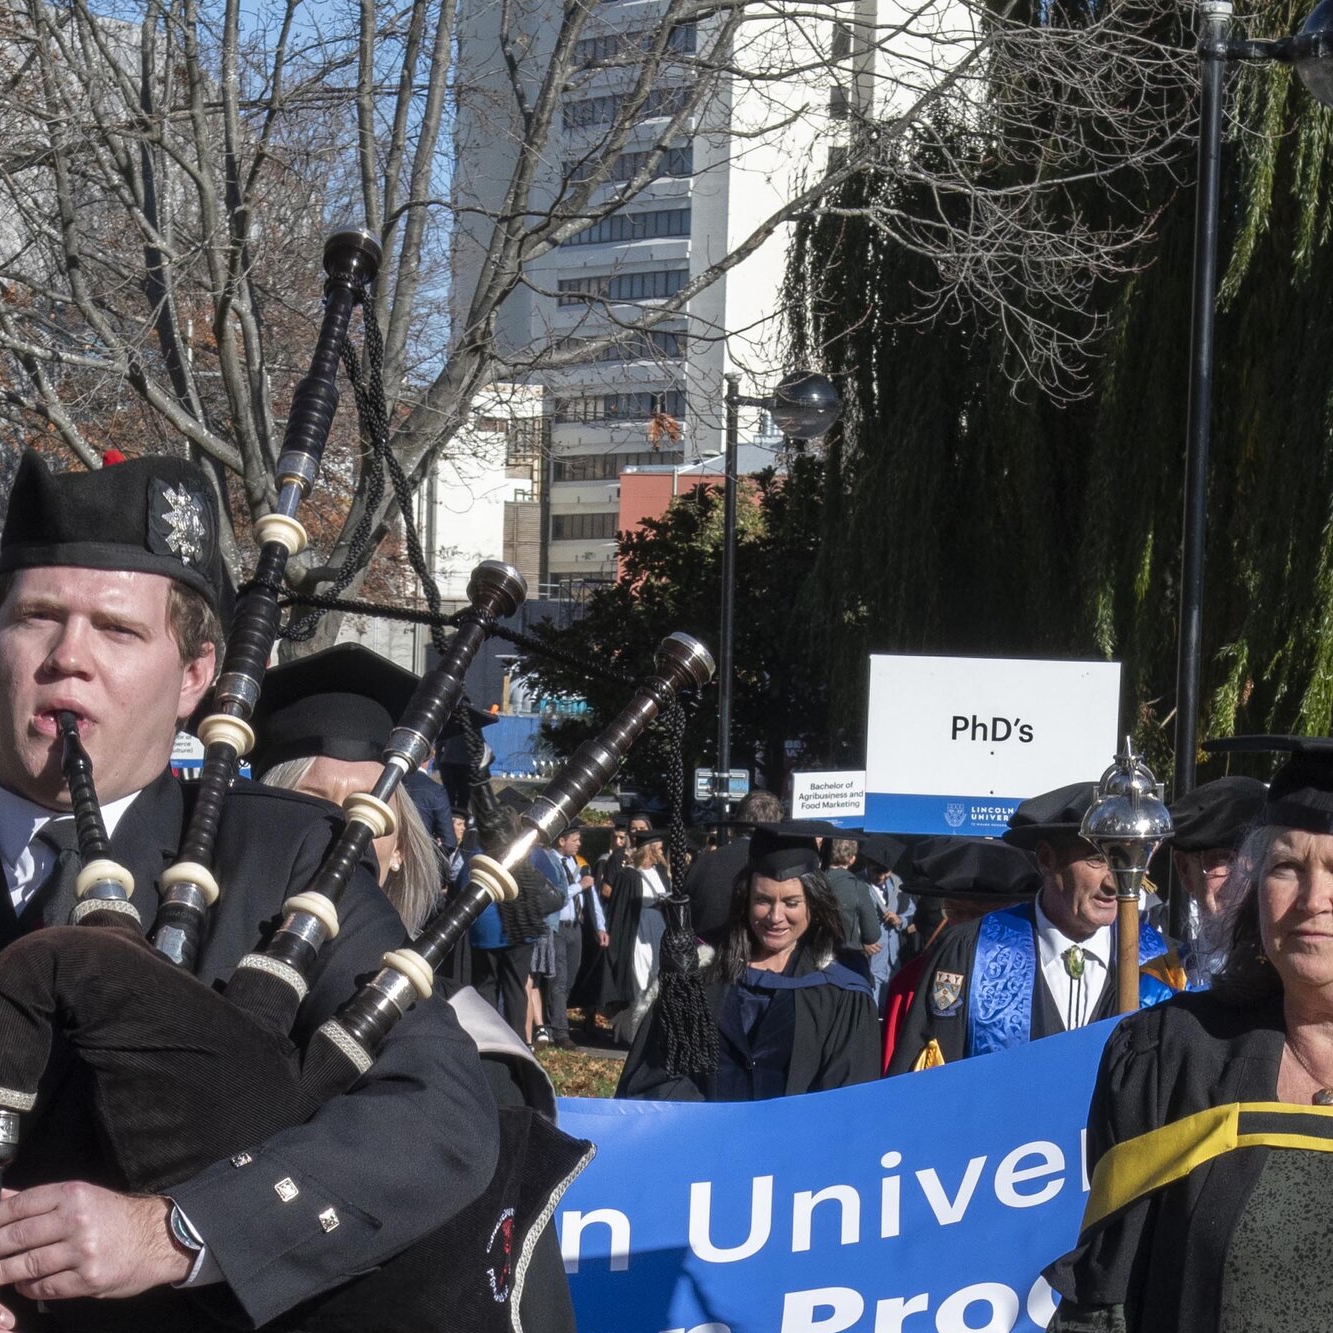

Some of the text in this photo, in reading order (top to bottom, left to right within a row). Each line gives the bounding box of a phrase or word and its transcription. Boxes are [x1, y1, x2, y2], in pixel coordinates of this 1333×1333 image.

[951, 715, 1034, 744] PhD's
[810, 781, 854, 790] Bachelor of
[798, 790, 864, 802] Agribusiness and
[801, 801, 860, 810] Food Marketing
[971, 806, 1014, 814] LINCOLN
